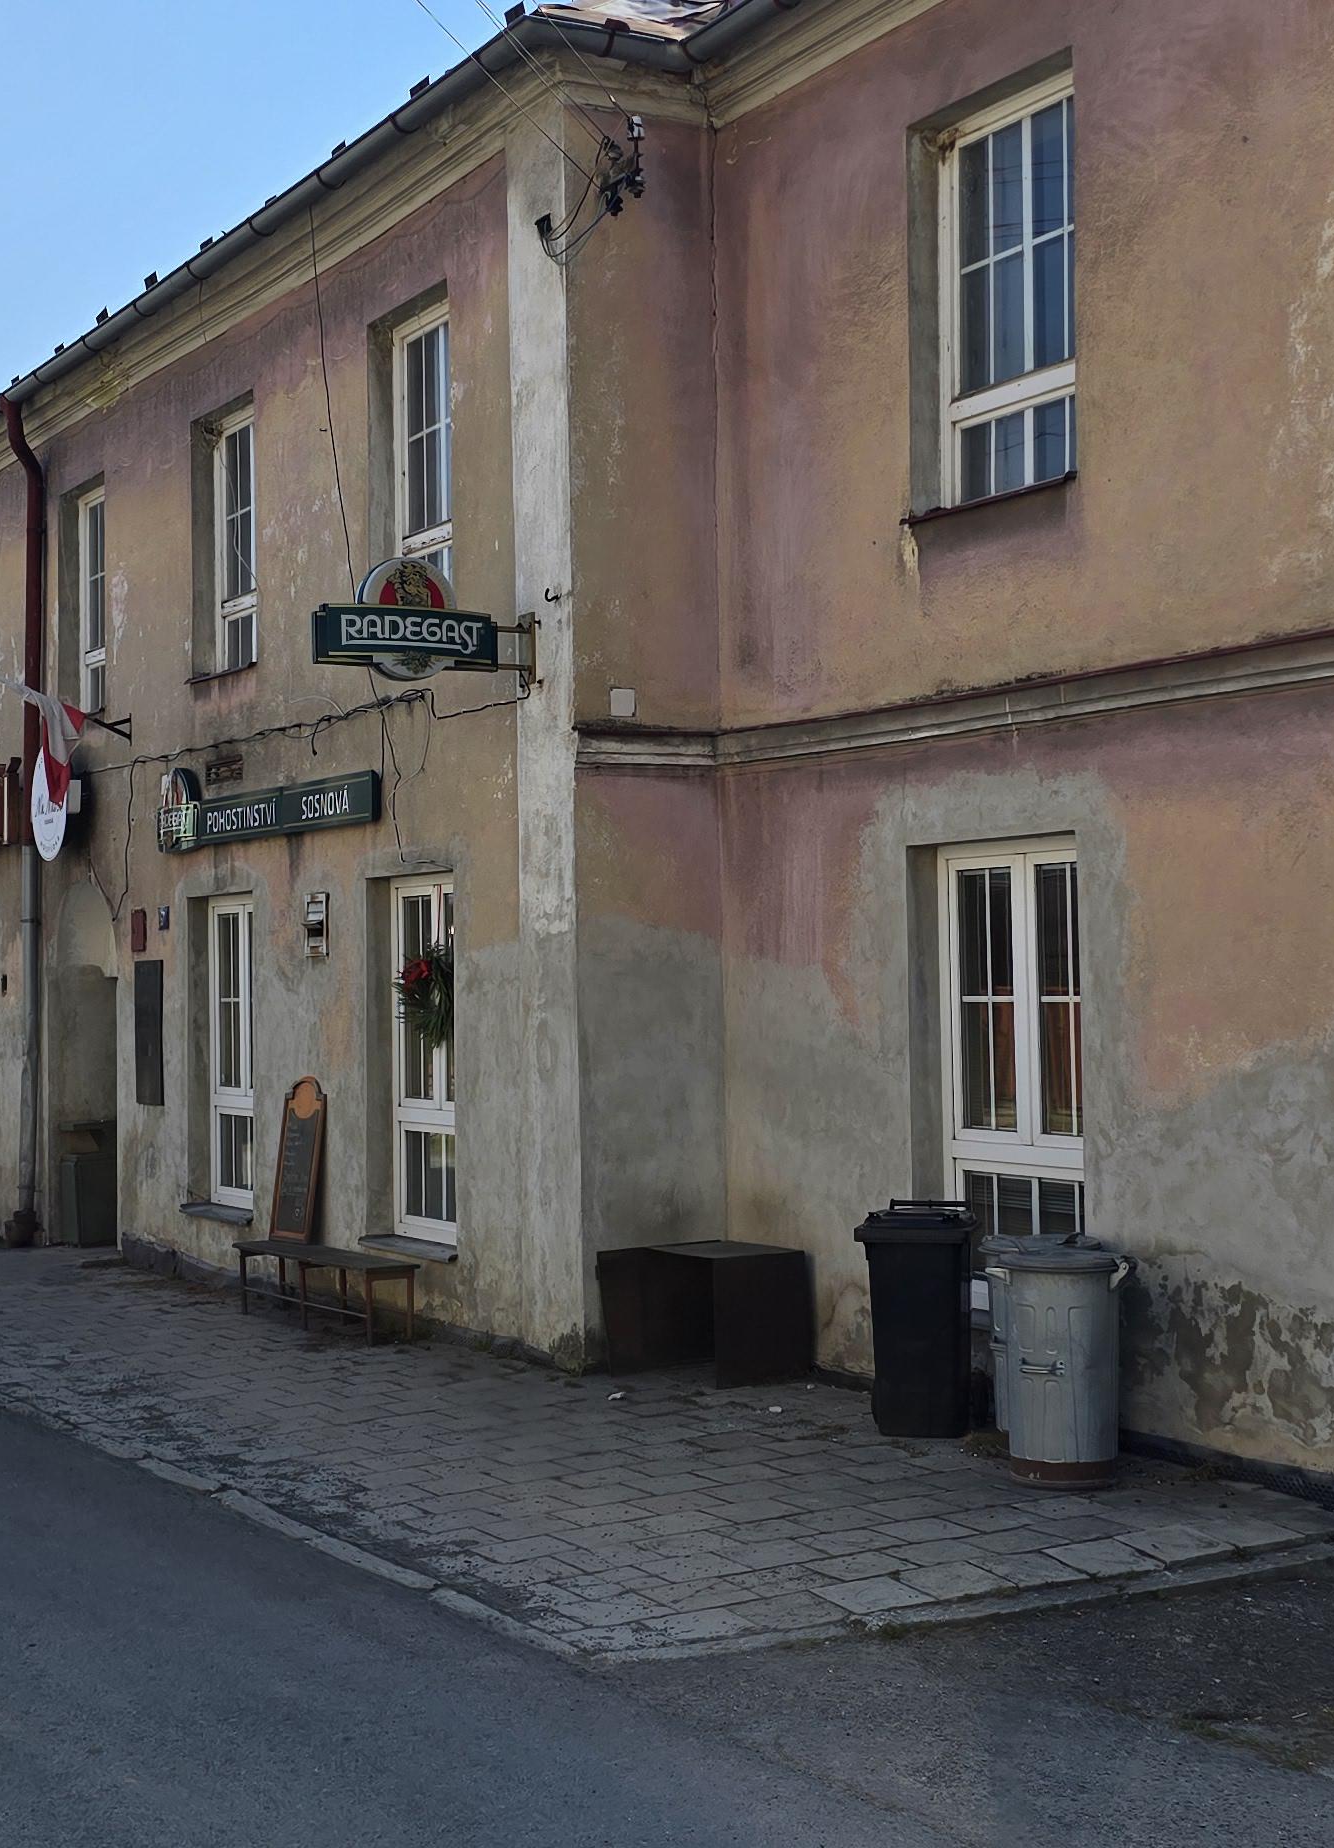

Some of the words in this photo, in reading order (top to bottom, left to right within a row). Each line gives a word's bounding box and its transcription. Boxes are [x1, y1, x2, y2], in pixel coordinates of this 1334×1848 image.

[340, 613, 483, 655] RADEGAST
[206, 798, 276, 834] POHOSTINSTVÍ
[301, 785, 350, 820] SOSNOVÁ
